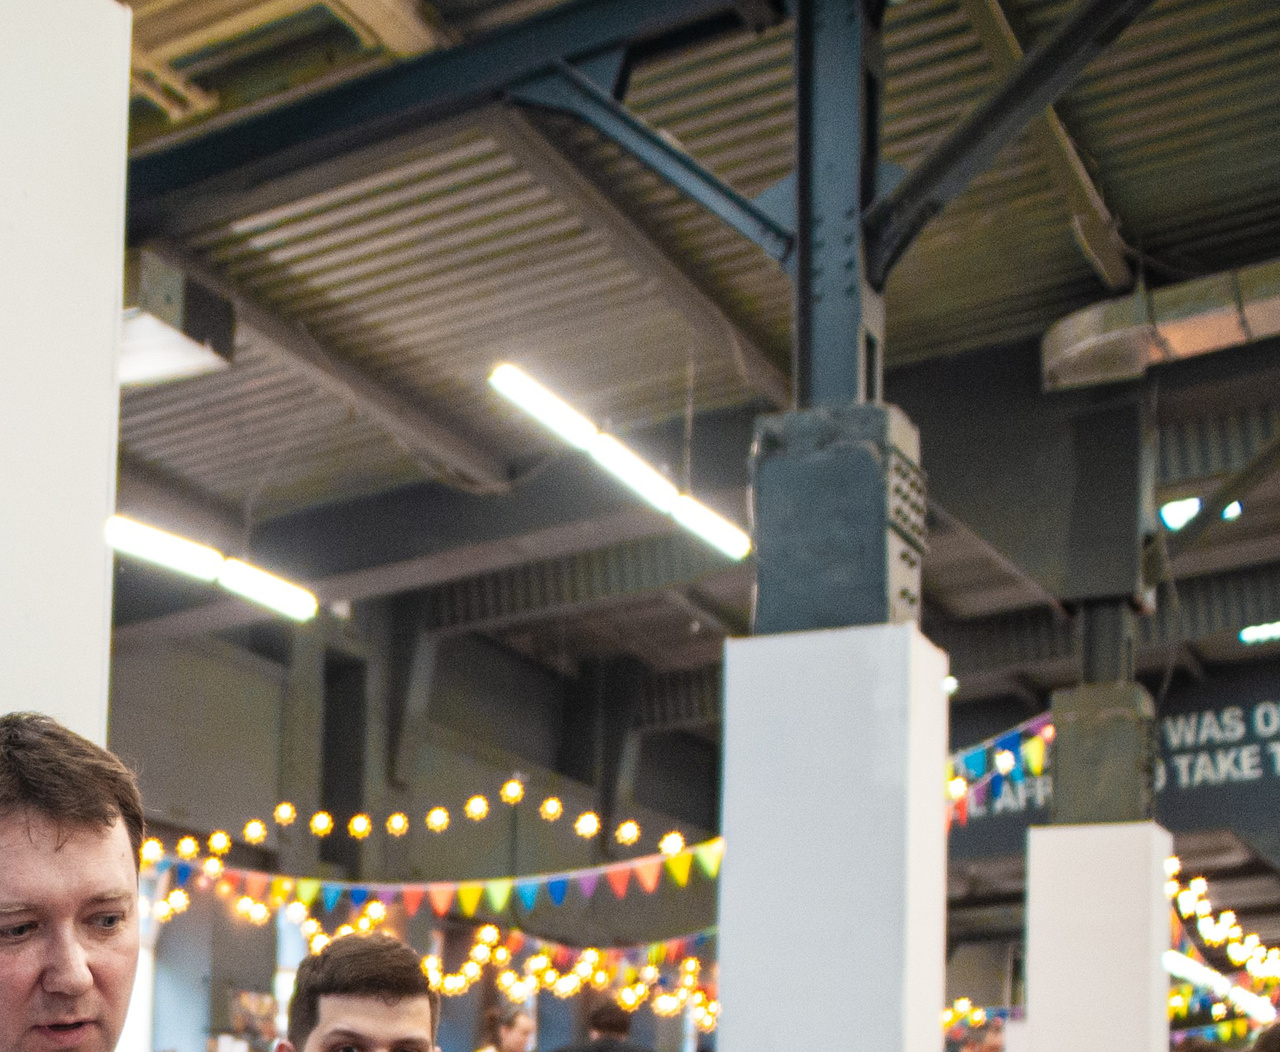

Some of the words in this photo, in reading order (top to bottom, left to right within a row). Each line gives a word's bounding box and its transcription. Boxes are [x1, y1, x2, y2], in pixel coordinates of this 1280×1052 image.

[1164, 705, 1246, 749] WAS
[1255, 700, 1280, 738] O
[1173, 744, 1264, 788] TAKE
